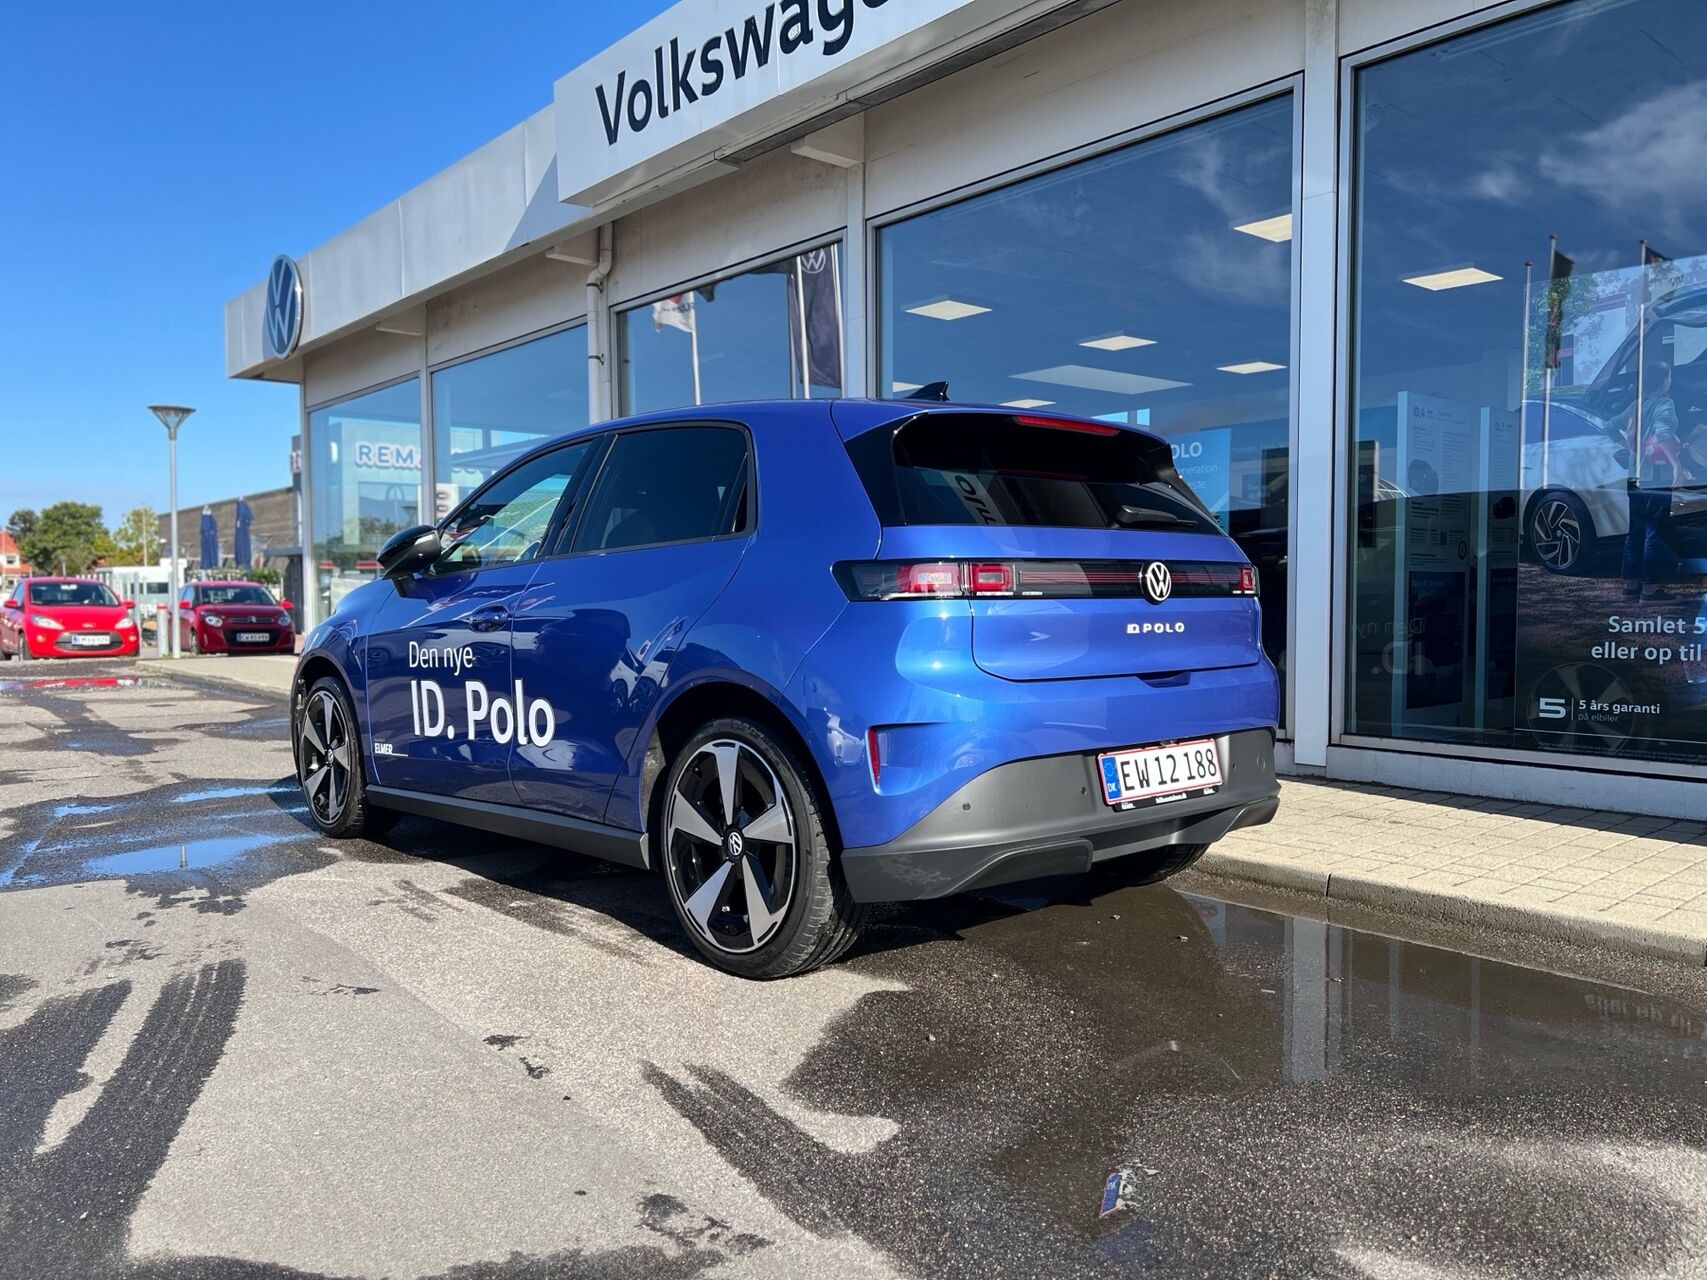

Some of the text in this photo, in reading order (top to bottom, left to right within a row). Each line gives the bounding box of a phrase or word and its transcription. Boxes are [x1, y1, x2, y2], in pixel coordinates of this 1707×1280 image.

[595, 0, 888, 146] Volkswag
[356, 442, 421, 470] REM
[1171, 441, 1203, 460] OLO
[1178, 464, 1218, 475] eneration
[1143, 622, 1185, 634] POLO
[1608, 615, 1686, 635] Samlet
[409, 641, 473, 676] Den nye
[1591, 641, 1702, 664] eller op til
[410, 678, 555, 747] ID. Polo
[1578, 700, 1660, 715] 5 års garanti
[1578, 713, 1618, 723] på elbiler
[1120, 748, 1217, 792] EW 12 188
[1107, 783, 1118, 793] DK
